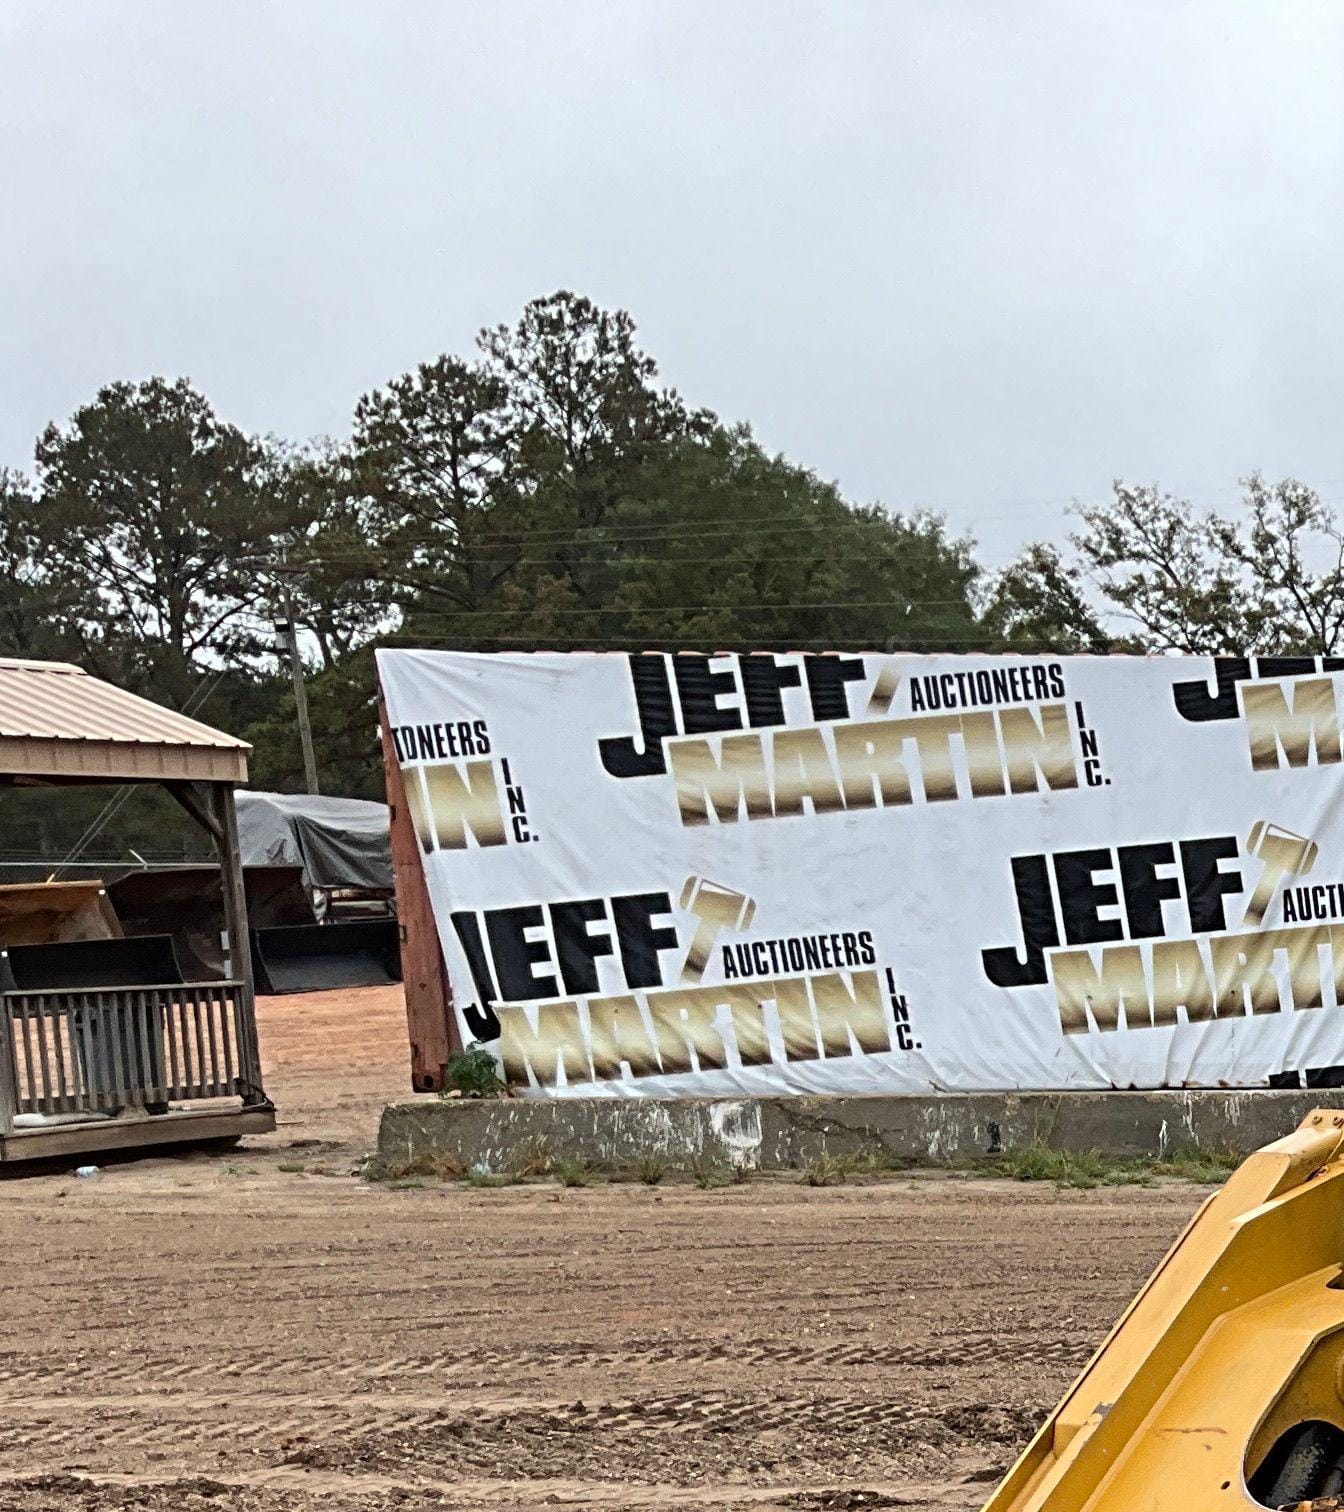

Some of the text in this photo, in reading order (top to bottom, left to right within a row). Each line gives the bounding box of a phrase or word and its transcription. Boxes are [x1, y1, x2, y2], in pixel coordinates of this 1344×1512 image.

[598, 654, 866, 778] JEFF
[909, 663, 1066, 712] AUCTIONEERS
[669, 703, 1079, 827] MARTIN
[450, 891, 679, 1043] JEFF
[722, 930, 877, 980] AUCTIONEERS
[981, 836, 1244, 988] JEFF
[498, 969, 892, 1088] MARTIN
